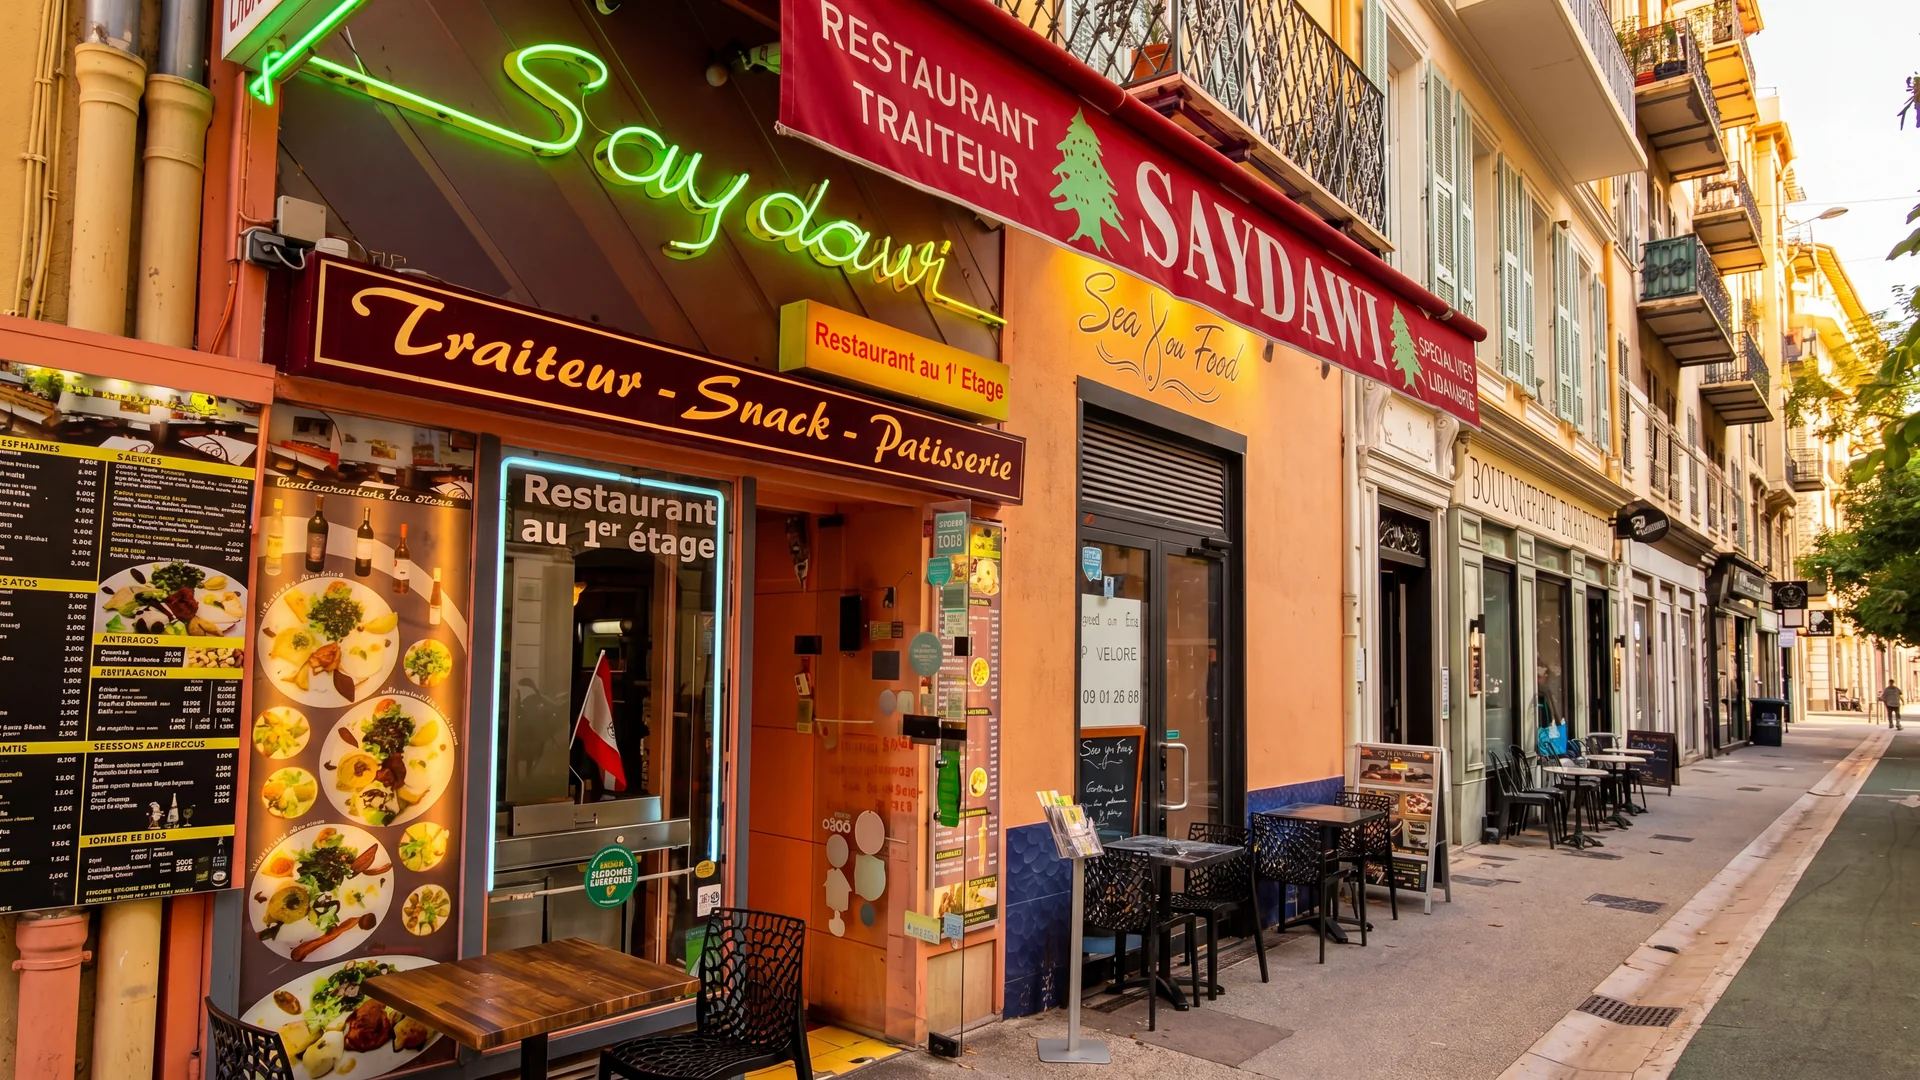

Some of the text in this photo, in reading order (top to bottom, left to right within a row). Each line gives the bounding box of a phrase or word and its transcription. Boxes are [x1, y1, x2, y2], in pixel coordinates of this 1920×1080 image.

[821, 0, 1038, 150] RESTAURANT
[853, 80, 1019, 196] TRAITEUR
[1135, 161, 1387, 370] SAYDAWI
[815, 321, 915, 374] Restaurant
[920, 358, 940, 380] au
[961, 367, 1004, 402] Etage
[1079, 272, 1142, 338] Sea
[1194, 325, 1245, 382] Food
[351, 287, 642, 397] Traiteur
[681, 375, 830, 441] Snack
[870, 414, 1012, 480] Patisserie
[521, 518, 715, 563] au 1er étage
[524, 474, 717, 526] Restaurant
[1083, 690, 1139, 704] 09 01 26 88
[1096, 647, 1137, 661] VELORE
